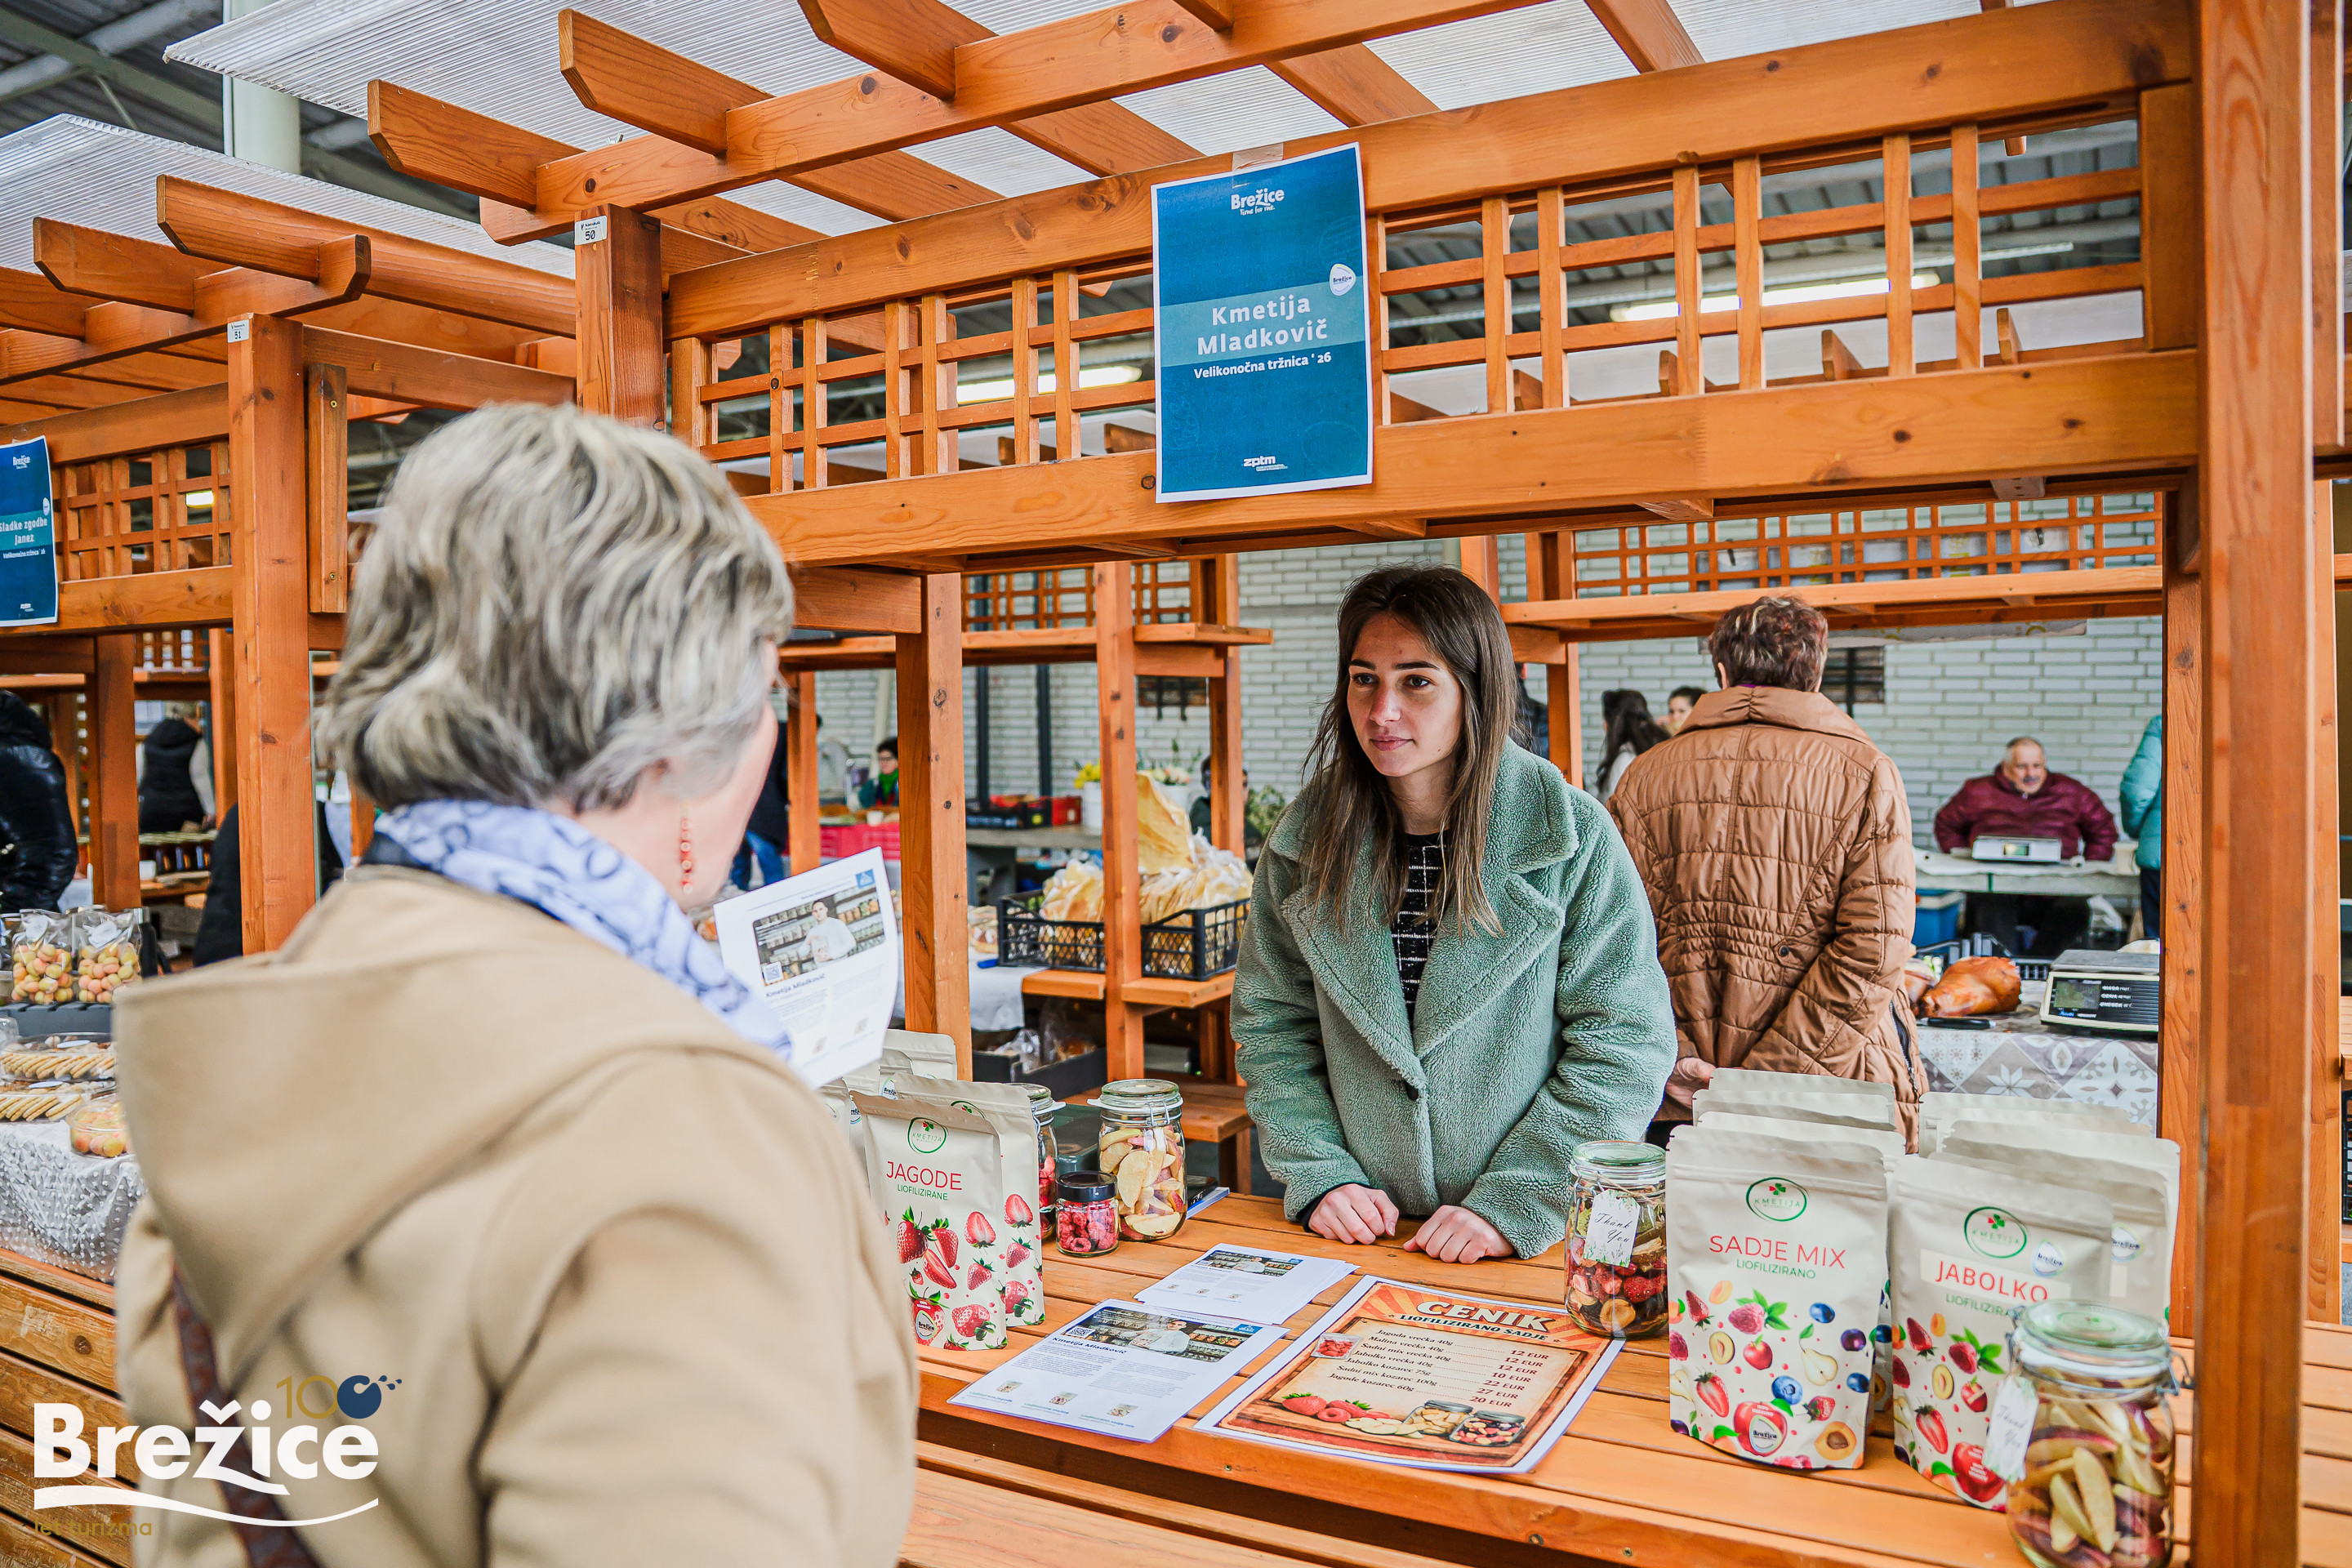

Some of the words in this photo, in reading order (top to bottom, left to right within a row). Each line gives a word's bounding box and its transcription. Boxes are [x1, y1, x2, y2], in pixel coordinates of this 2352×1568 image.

[1231, 188, 1285, 210] Brežice
[585, 229, 595, 241] 50
[1212, 294, 1311, 326] Kmetija
[234, 331, 242, 340] 51
[1197, 318, 1328, 355] Mladkovič
[1194, 361, 1265, 379] Velikonočna
[1267, 354, 1309, 370] tržnica
[1243, 455, 1276, 467] zptm
[24, 516, 47, 531] zgodbe
[15, 534, 34, 546] Janez
[912, 1133, 942, 1142] KMETIJA
[886, 1160, 962, 1190] JAGODE
[897, 1184, 948, 1200] LIOFILIZIRANE
[1754, 1197, 1800, 1208] KMETIJA
[1594, 1213, 1633, 1229] Thank
[1607, 1229, 1629, 1244] You
[1709, 1236, 1788, 1261] SADJE
[1797, 1244, 1846, 1269] MIX
[1736, 1258, 1815, 1279] LIOFILIZIRANO
[1935, 1260, 2048, 1303] JABOLKO
[1417, 1301, 1556, 1333] CENIK
[1376, 1330, 1406, 1339] Jagoda
[1400, 1314, 1500, 1332] LIOFILIZIRANO
[1503, 1327, 1548, 1341] SADJE
[1052, 1337, 1084, 1346] Kmetija
[1085, 1343, 1127, 1354] Mladkovič
[1369, 1336, 1397, 1345] Malina
[1400, 1341, 1426, 1349] vrečka
[1352, 1350, 1386, 1360] Jabolko
[1388, 1356, 1414, 1365] vrečka
[1361, 1343, 1386, 1352] Sadni
[1406, 1351, 1432, 1359] vrečka
[1345, 1357, 1379, 1367] Jabolko
[1381, 1363, 1414, 1373] kozarec
[1328, 1373, 1360, 1383] Jagode
[1361, 1379, 1396, 1388] kozarec
[1337, 1365, 1361, 1374] Sadni
[1381, 1372, 1414, 1382] kozarec
